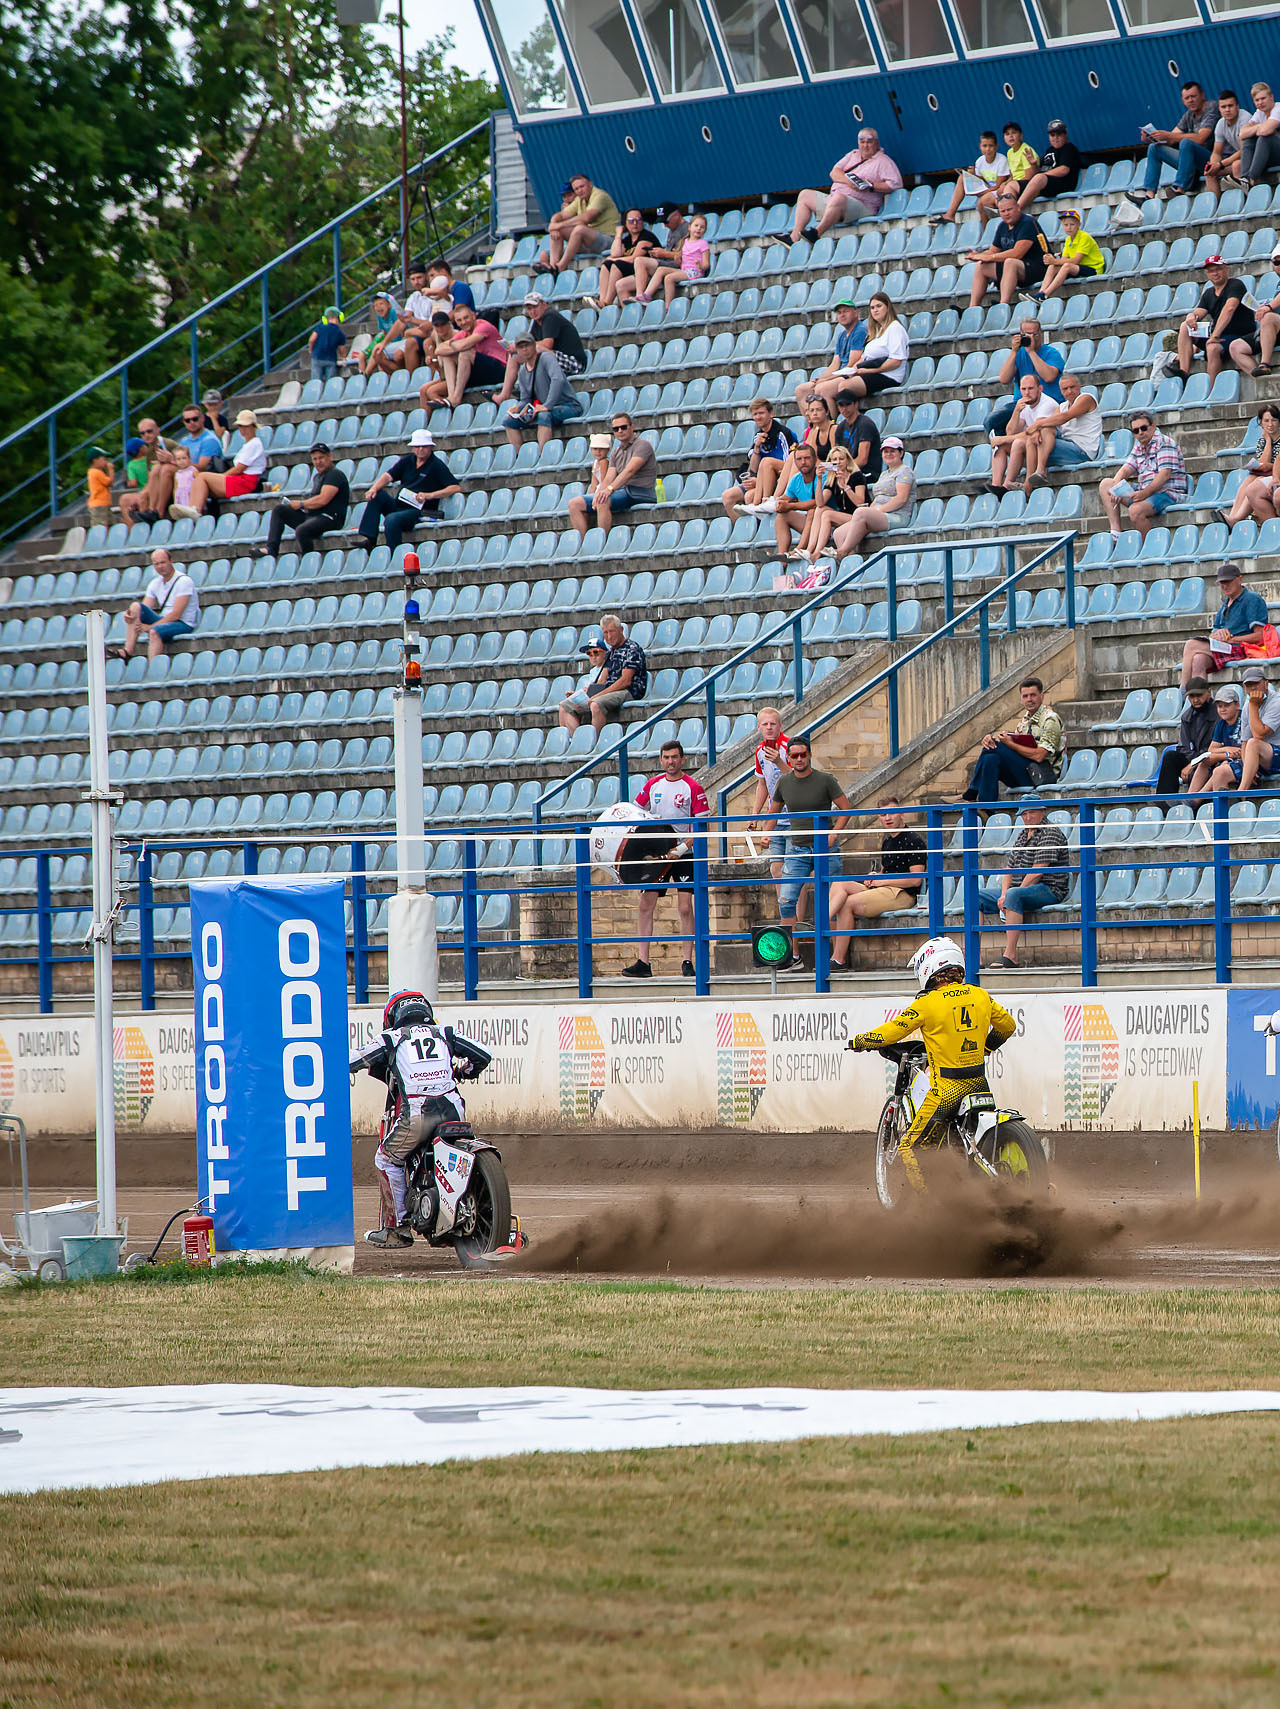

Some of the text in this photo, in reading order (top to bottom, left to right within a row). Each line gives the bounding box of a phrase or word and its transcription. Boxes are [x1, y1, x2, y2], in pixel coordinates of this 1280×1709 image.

[611, 1016, 683, 1045] DAUGAVPILS
[773, 1012, 848, 1041] DAUGAVPILS
[961, 1007, 972, 1028] 4
[1126, 1005, 1210, 1035] DAUGAVPILS
[18, 1031, 80, 1057] DAUGAVPILS
[159, 1028, 195, 1054] DAUGA
[411, 1037, 438, 1060] 12
[202, 921, 230, 1213] TRODO
[278, 918, 328, 1211] TRODO
[611, 1056, 664, 1085] IR SPORTS
[772, 1053, 843, 1082] IS SPEEDWAY
[1125, 1047, 1203, 1077] IS SPEEDWAY
[19, 1068, 66, 1094] IR SPORTS
[159, 1065, 195, 1091] IS SPEE
